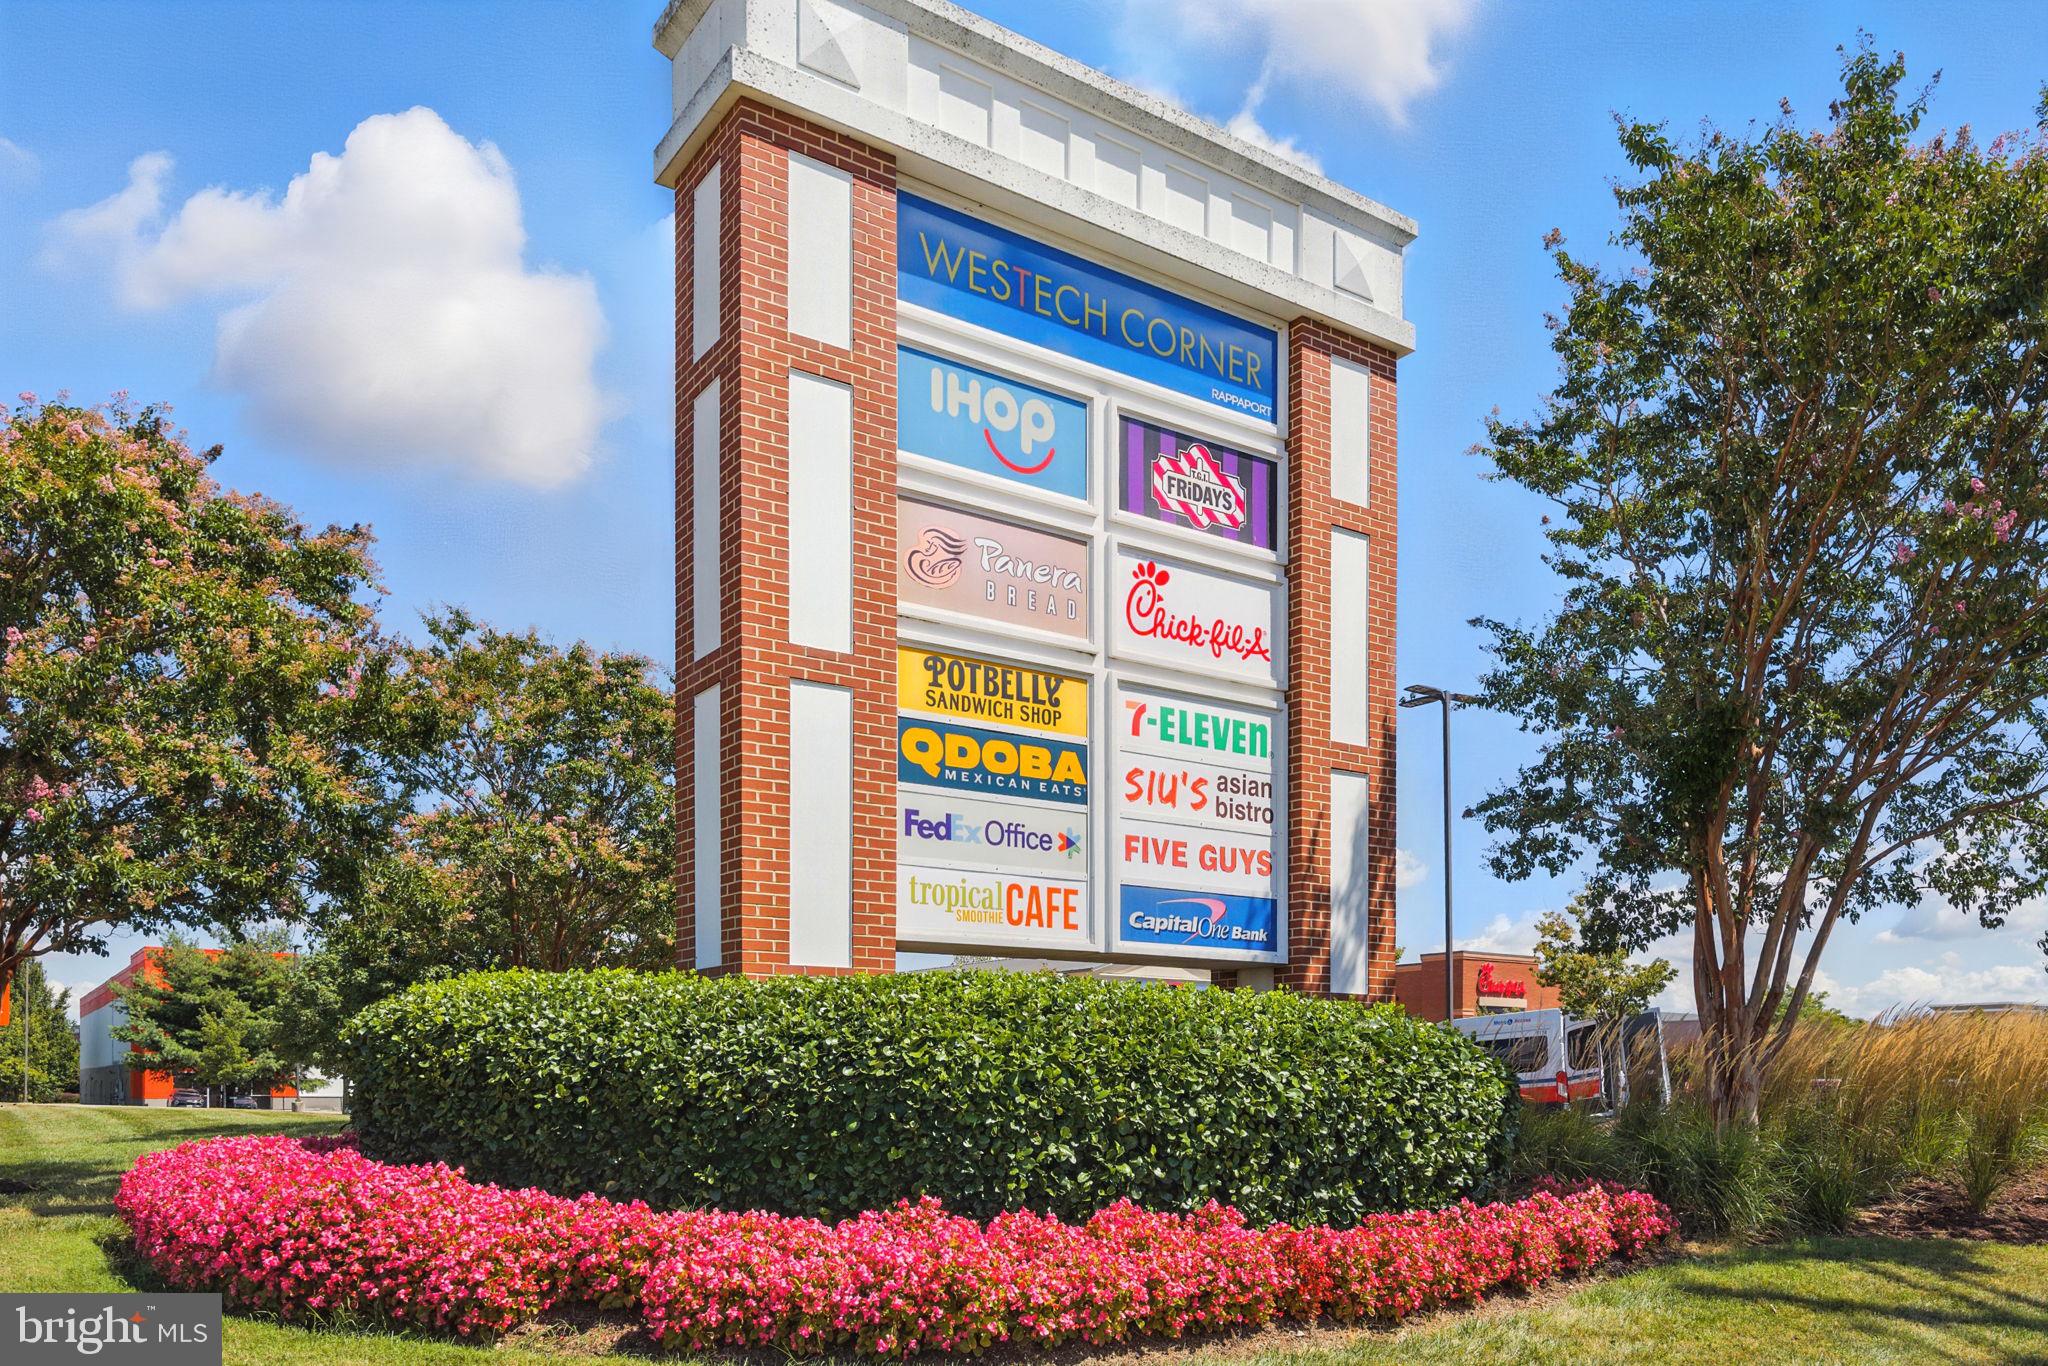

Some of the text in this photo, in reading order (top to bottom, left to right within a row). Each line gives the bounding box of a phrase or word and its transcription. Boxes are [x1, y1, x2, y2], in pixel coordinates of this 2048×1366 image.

[919, 231, 1263, 389] WESTECH CORNER
[1211, 388, 1273, 416] RAPPAPORT
[973, 536, 1083, 594] Panera
[985, 580, 1077, 619] BREAD
[1125, 577, 1271, 662] Chick-fil-A
[923, 655, 1064, 708] POTBELLY
[925, 689, 1062, 727] SANDWICH SHOP
[901, 727, 1087, 785] QDOBA
[945, 769, 1083, 797] MEXICAN EATS
[1216, 773, 1272, 799] asian
[904, 808, 1053, 851] FedEx Office
[1215, 796, 1274, 825] bistro
[1124, 834, 1273, 877] FIVE GUYS
[909, 875, 1004, 913] tropical
[1006, 882, 1079, 931] CAFE
[956, 909, 1004, 924] SMOOTHIE
[1231, 926, 1268, 942] Bank
